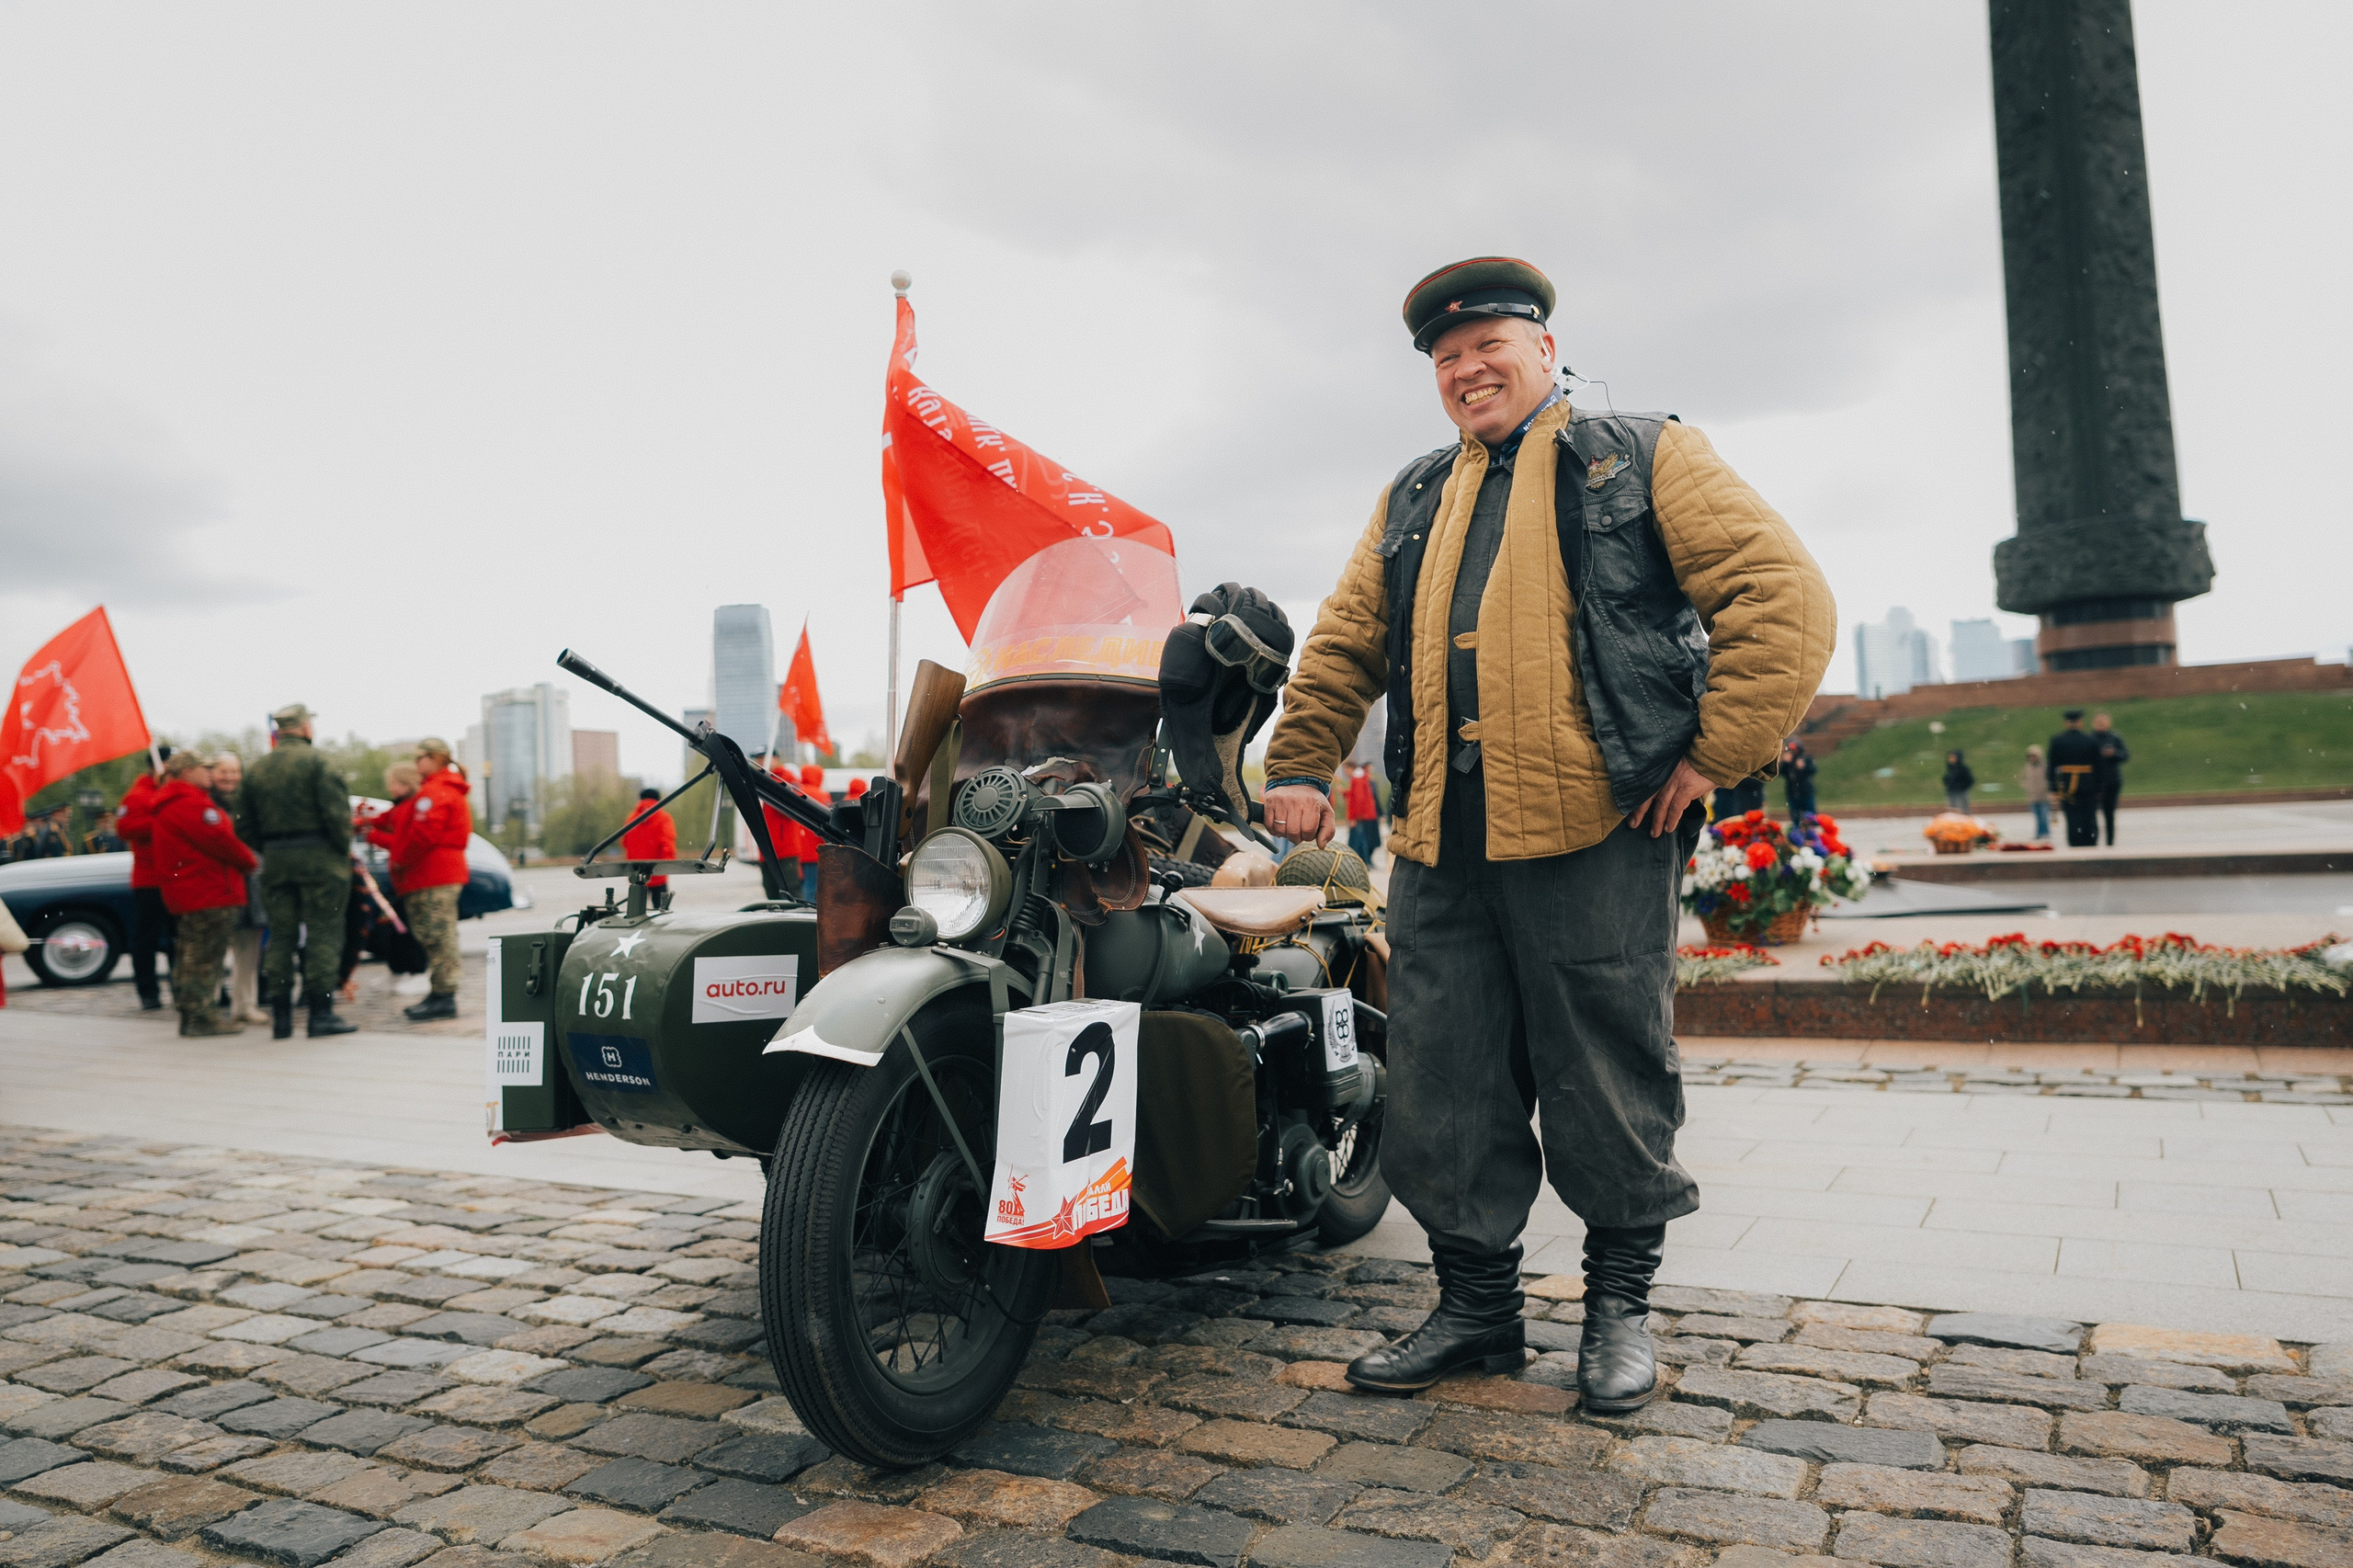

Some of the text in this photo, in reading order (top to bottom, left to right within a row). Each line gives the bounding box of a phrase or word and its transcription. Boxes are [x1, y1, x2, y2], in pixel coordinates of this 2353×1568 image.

[578, 971, 637, 1020] 151
[706, 980, 786, 998] auto.ru
[497, 1051, 531, 1059] ПАРИ
[585, 1071, 652, 1086] HENDERSON
[1063, 1021, 1116, 1165] 2
[1086, 1181, 1111, 1196] АЛЛИ
[998, 1199, 1014, 1215] 80
[996, 1215, 1025, 1226] ПОБЕДА!
